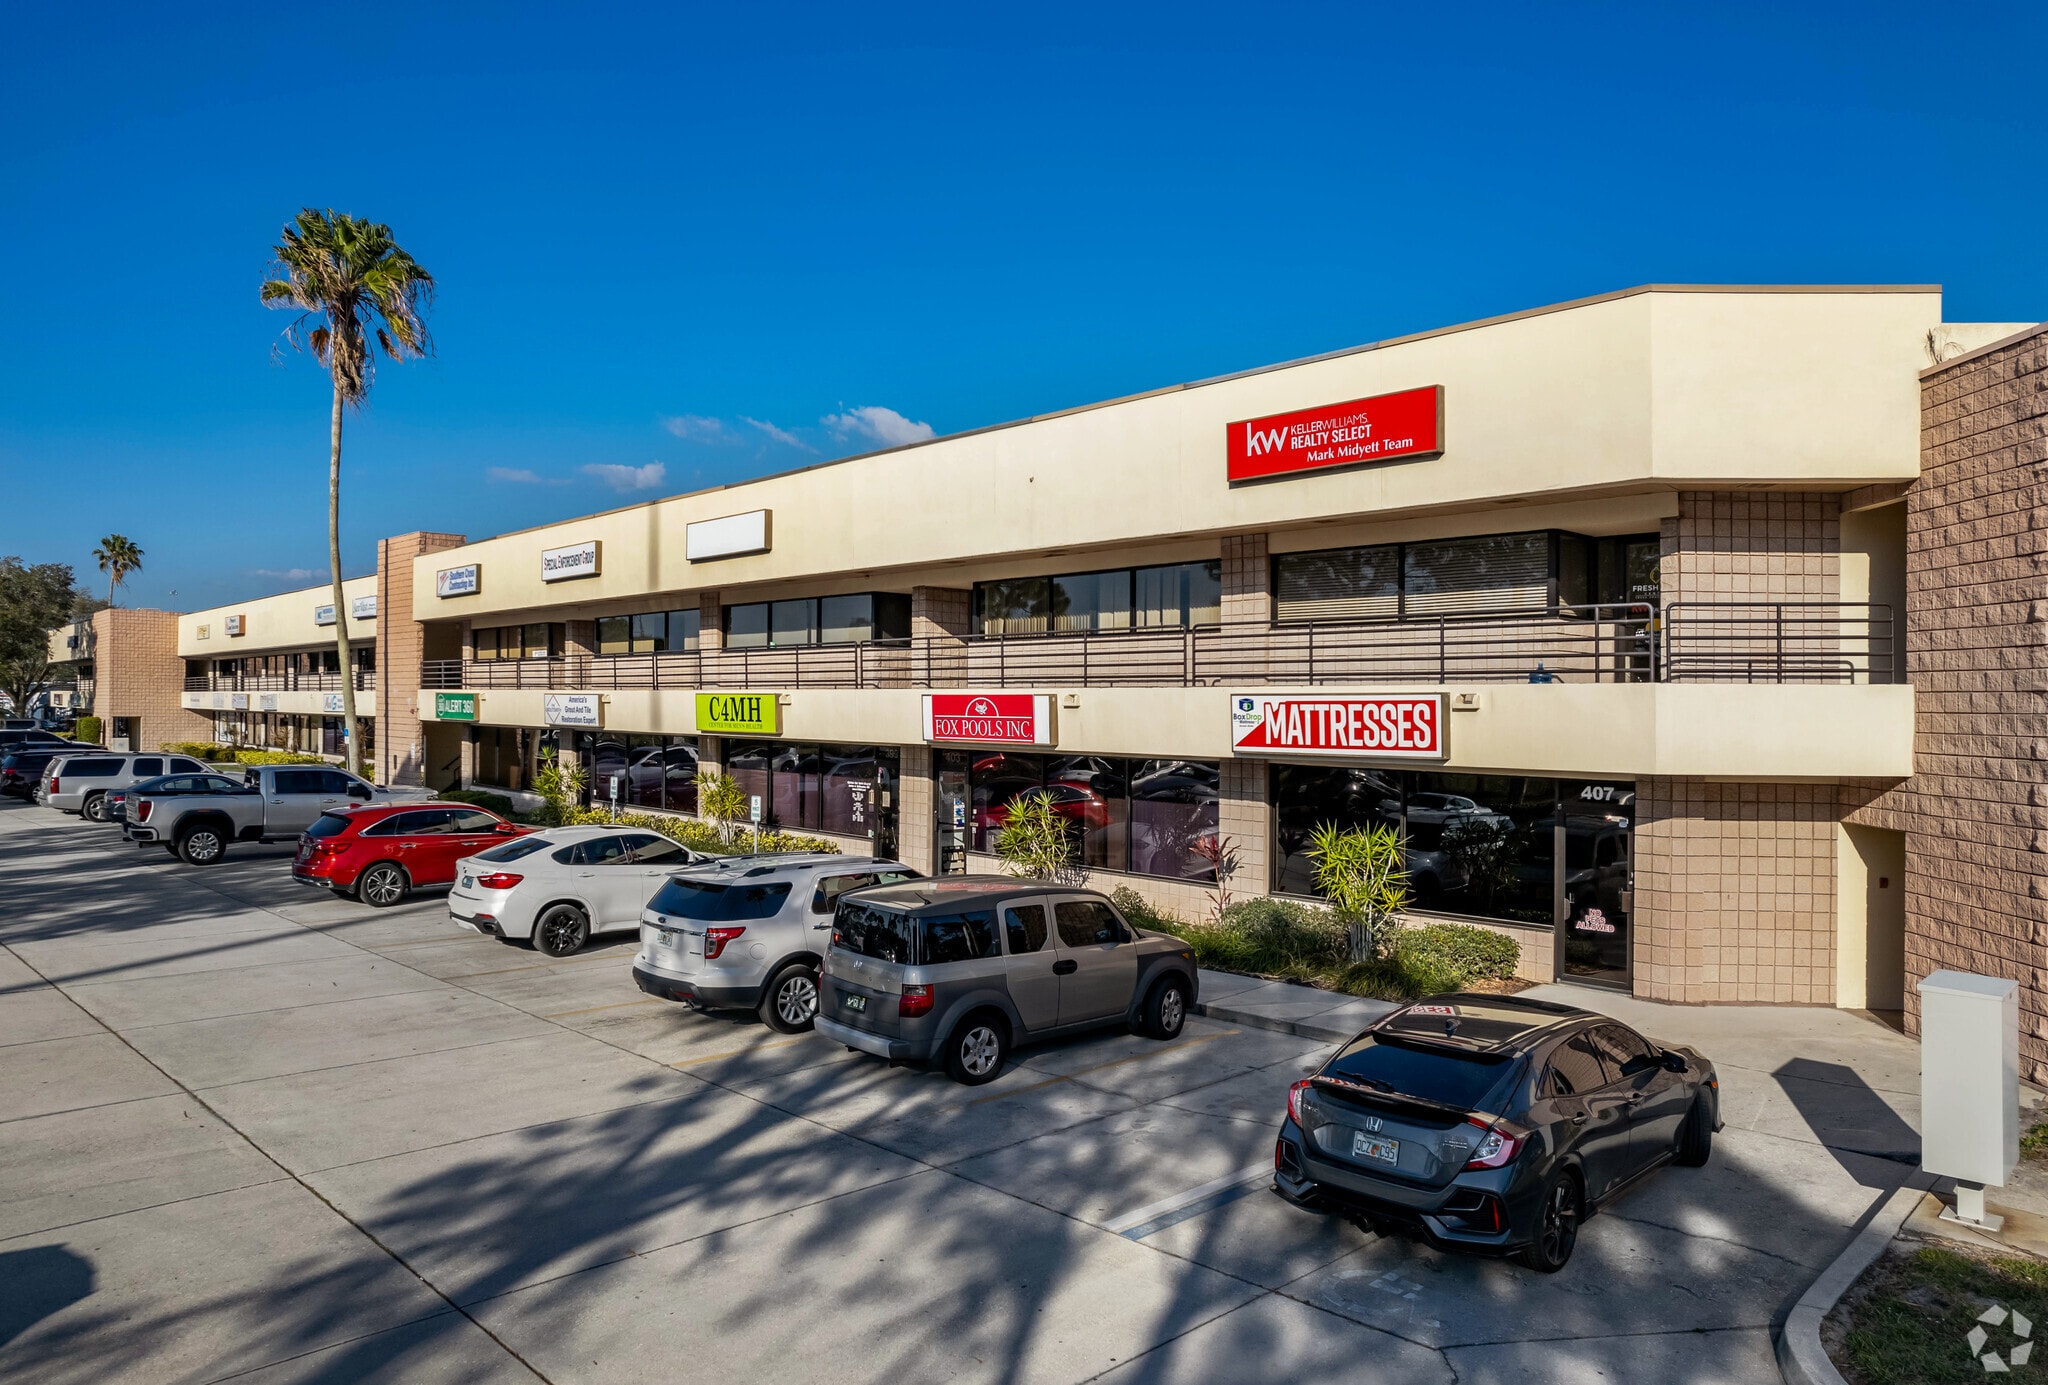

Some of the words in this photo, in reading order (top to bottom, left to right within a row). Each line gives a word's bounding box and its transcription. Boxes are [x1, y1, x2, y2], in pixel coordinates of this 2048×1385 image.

[1291, 413, 1367, 435] KELLERWILLIAMS
[1246, 422, 1288, 457] kw
[1291, 432, 1328, 450] REALTY
[1331, 424, 1372, 443] SELECT
[1306, 447, 1334, 462] Mark
[1337, 443, 1379, 458] Midyett
[1383, 437, 1413, 451] Team
[1632, 584, 1659, 592] FRESH
[444, 699, 462, 713] ALERT
[463, 699, 474, 714] 360
[709, 696, 762, 722] C4MH
[935, 719, 959, 735] FOX
[961, 719, 1003, 736] POOLS
[1006, 720, 1033, 738] INC.
[1265, 703, 1431, 749] MATTRESSES
[1580, 785, 1615, 801] 407
[1584, 914, 1606, 925] PETS
[1588, 908, 1602, 917] NO
[1575, 921, 1615, 933] ALLOWED
